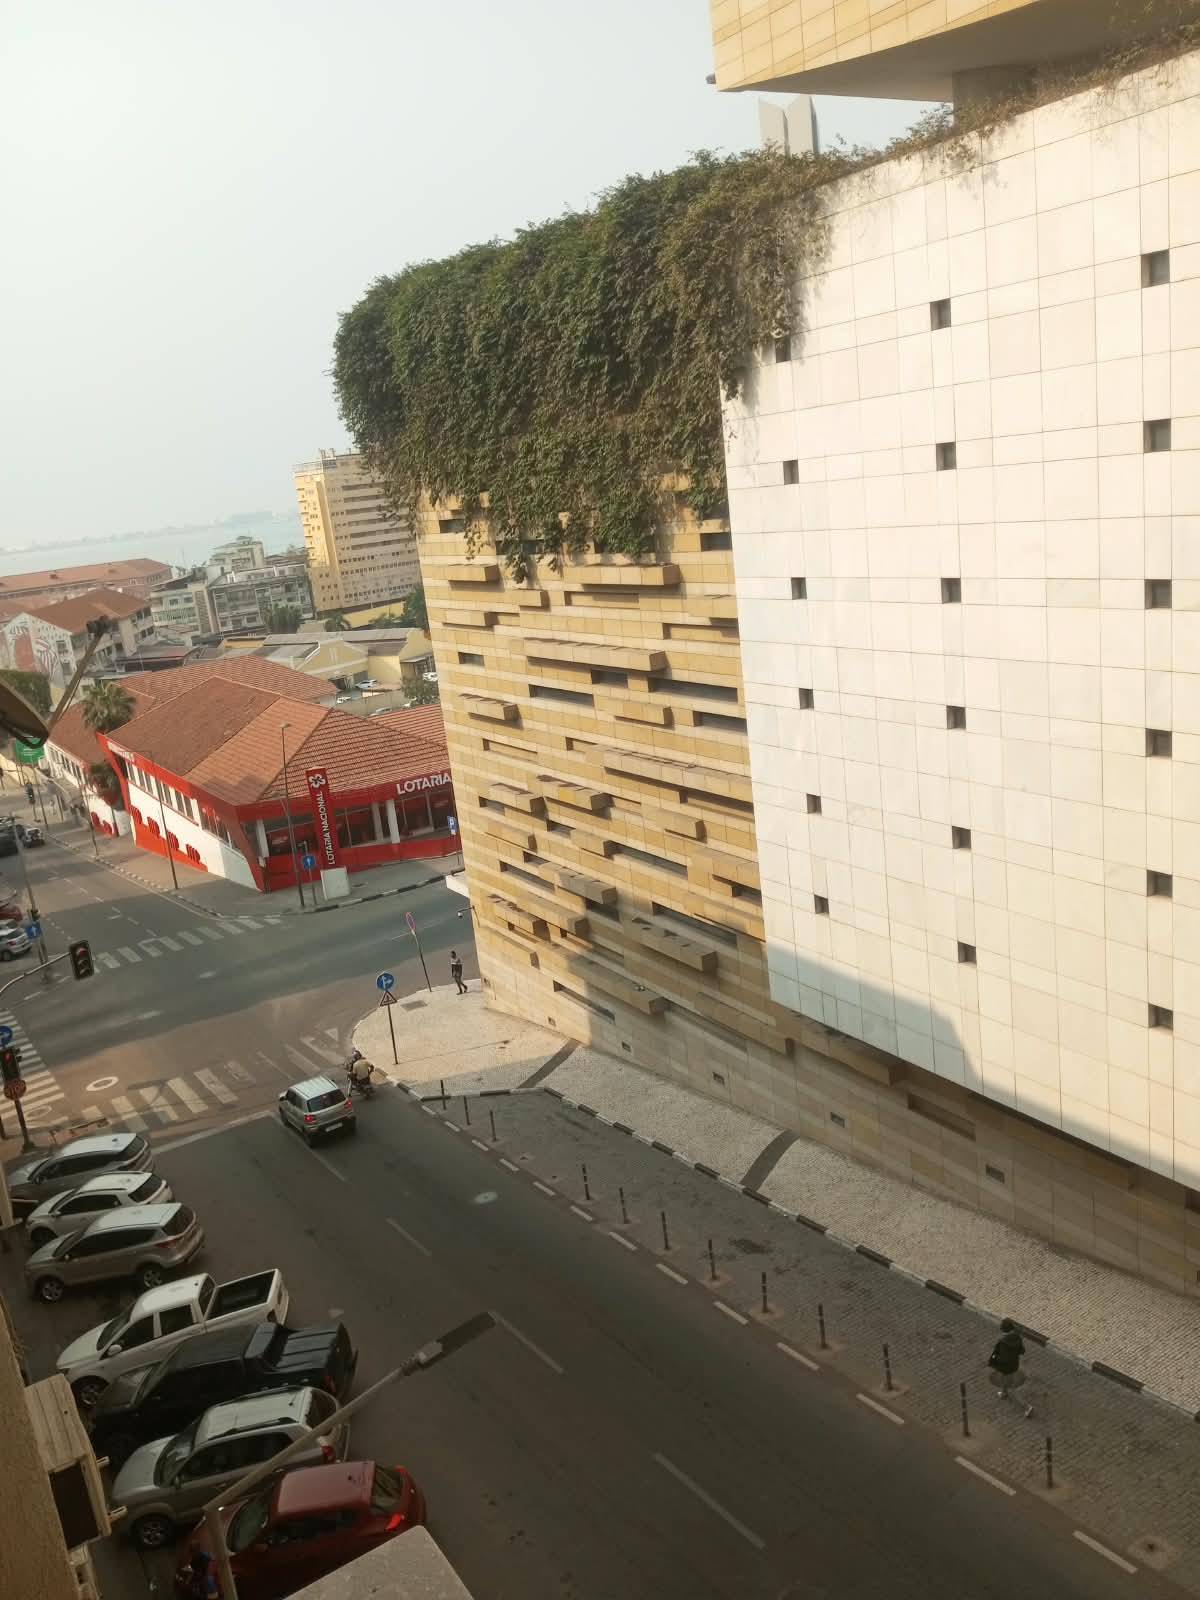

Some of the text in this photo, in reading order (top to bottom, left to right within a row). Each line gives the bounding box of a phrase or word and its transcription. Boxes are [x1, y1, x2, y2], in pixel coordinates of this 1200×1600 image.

[396, 773, 452, 795] LOTARIA
[317, 791, 335, 865] LOTARIA NACIONAL
